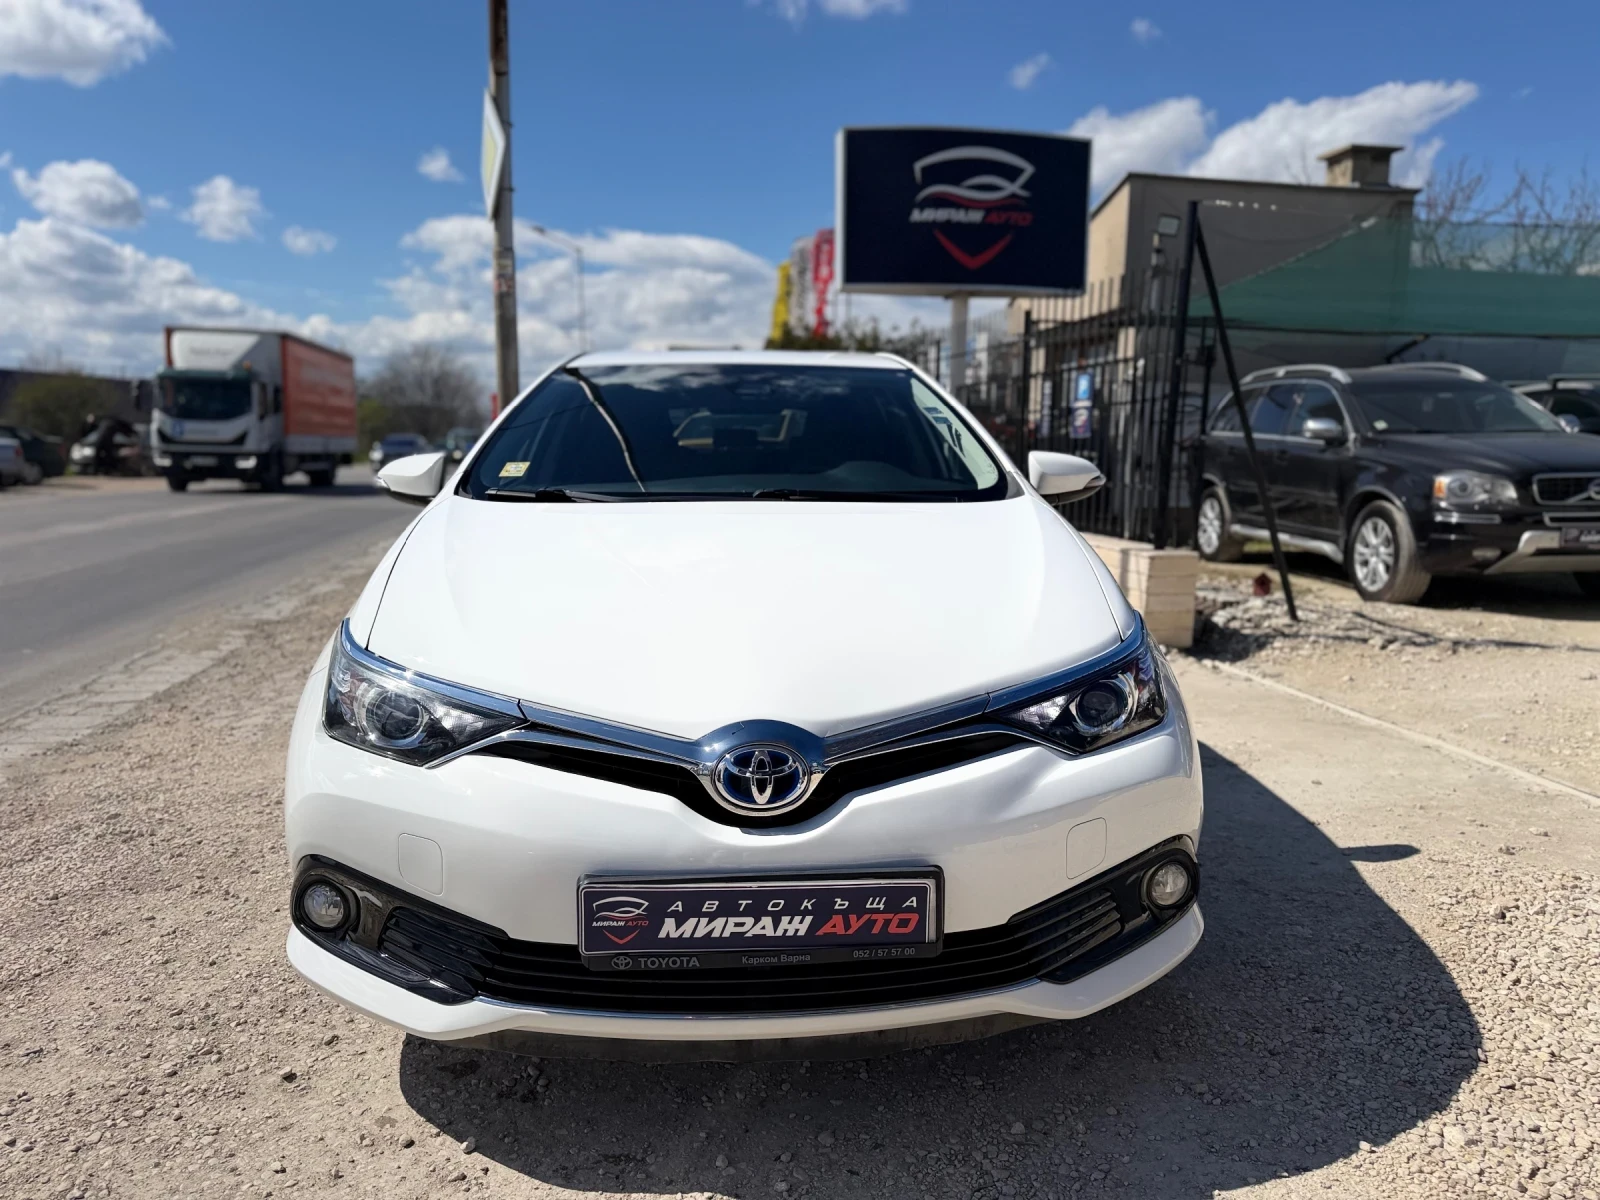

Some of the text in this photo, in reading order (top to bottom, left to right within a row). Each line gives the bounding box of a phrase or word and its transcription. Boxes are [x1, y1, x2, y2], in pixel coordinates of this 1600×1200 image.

[667, 897, 917, 912] АВТОКЪЩА
[657, 913, 920, 938] МИРАЖ АУТО
[741, 953, 811, 964] Карком Варна
[853, 950, 870, 958] 052
[878, 949, 890, 957] 57
[891, 949, 902, 957] 57
[904, 948, 916, 956] 00
[638, 957, 700, 968] TOYOTA
